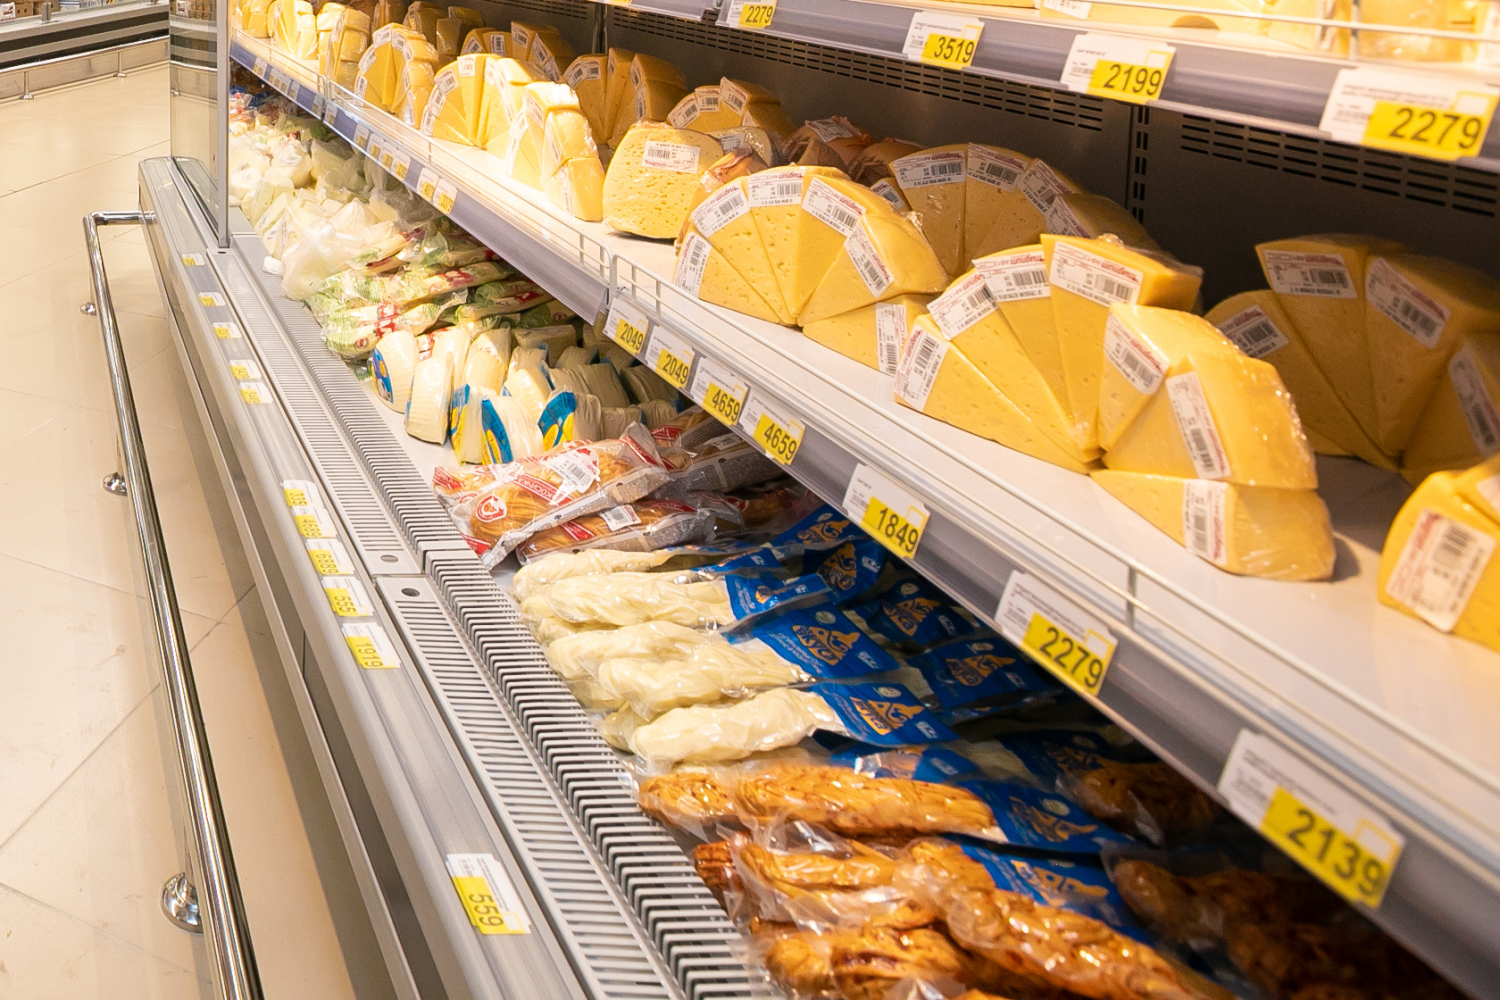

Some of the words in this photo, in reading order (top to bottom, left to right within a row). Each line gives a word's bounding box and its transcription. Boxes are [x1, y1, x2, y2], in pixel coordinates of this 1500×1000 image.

[744, 4, 774, 26] 2279
[932, 35, 975, 66] 3519
[1103, 63, 1165, 99] 2199
[1387, 107, 1482, 150] 2279
[620, 322, 644, 351] 2049
[661, 353, 689, 385] 2049
[712, 388, 741, 422] 4659
[764, 422, 798, 461] 4659
[878, 506, 919, 554] 1849
[334, 595, 357, 614] 555
[355, 641, 384, 668] 1919
[1041, 625, 1104, 692] 2279
[1287, 805, 1388, 901] 2139
[468, 893, 504, 929] 559
